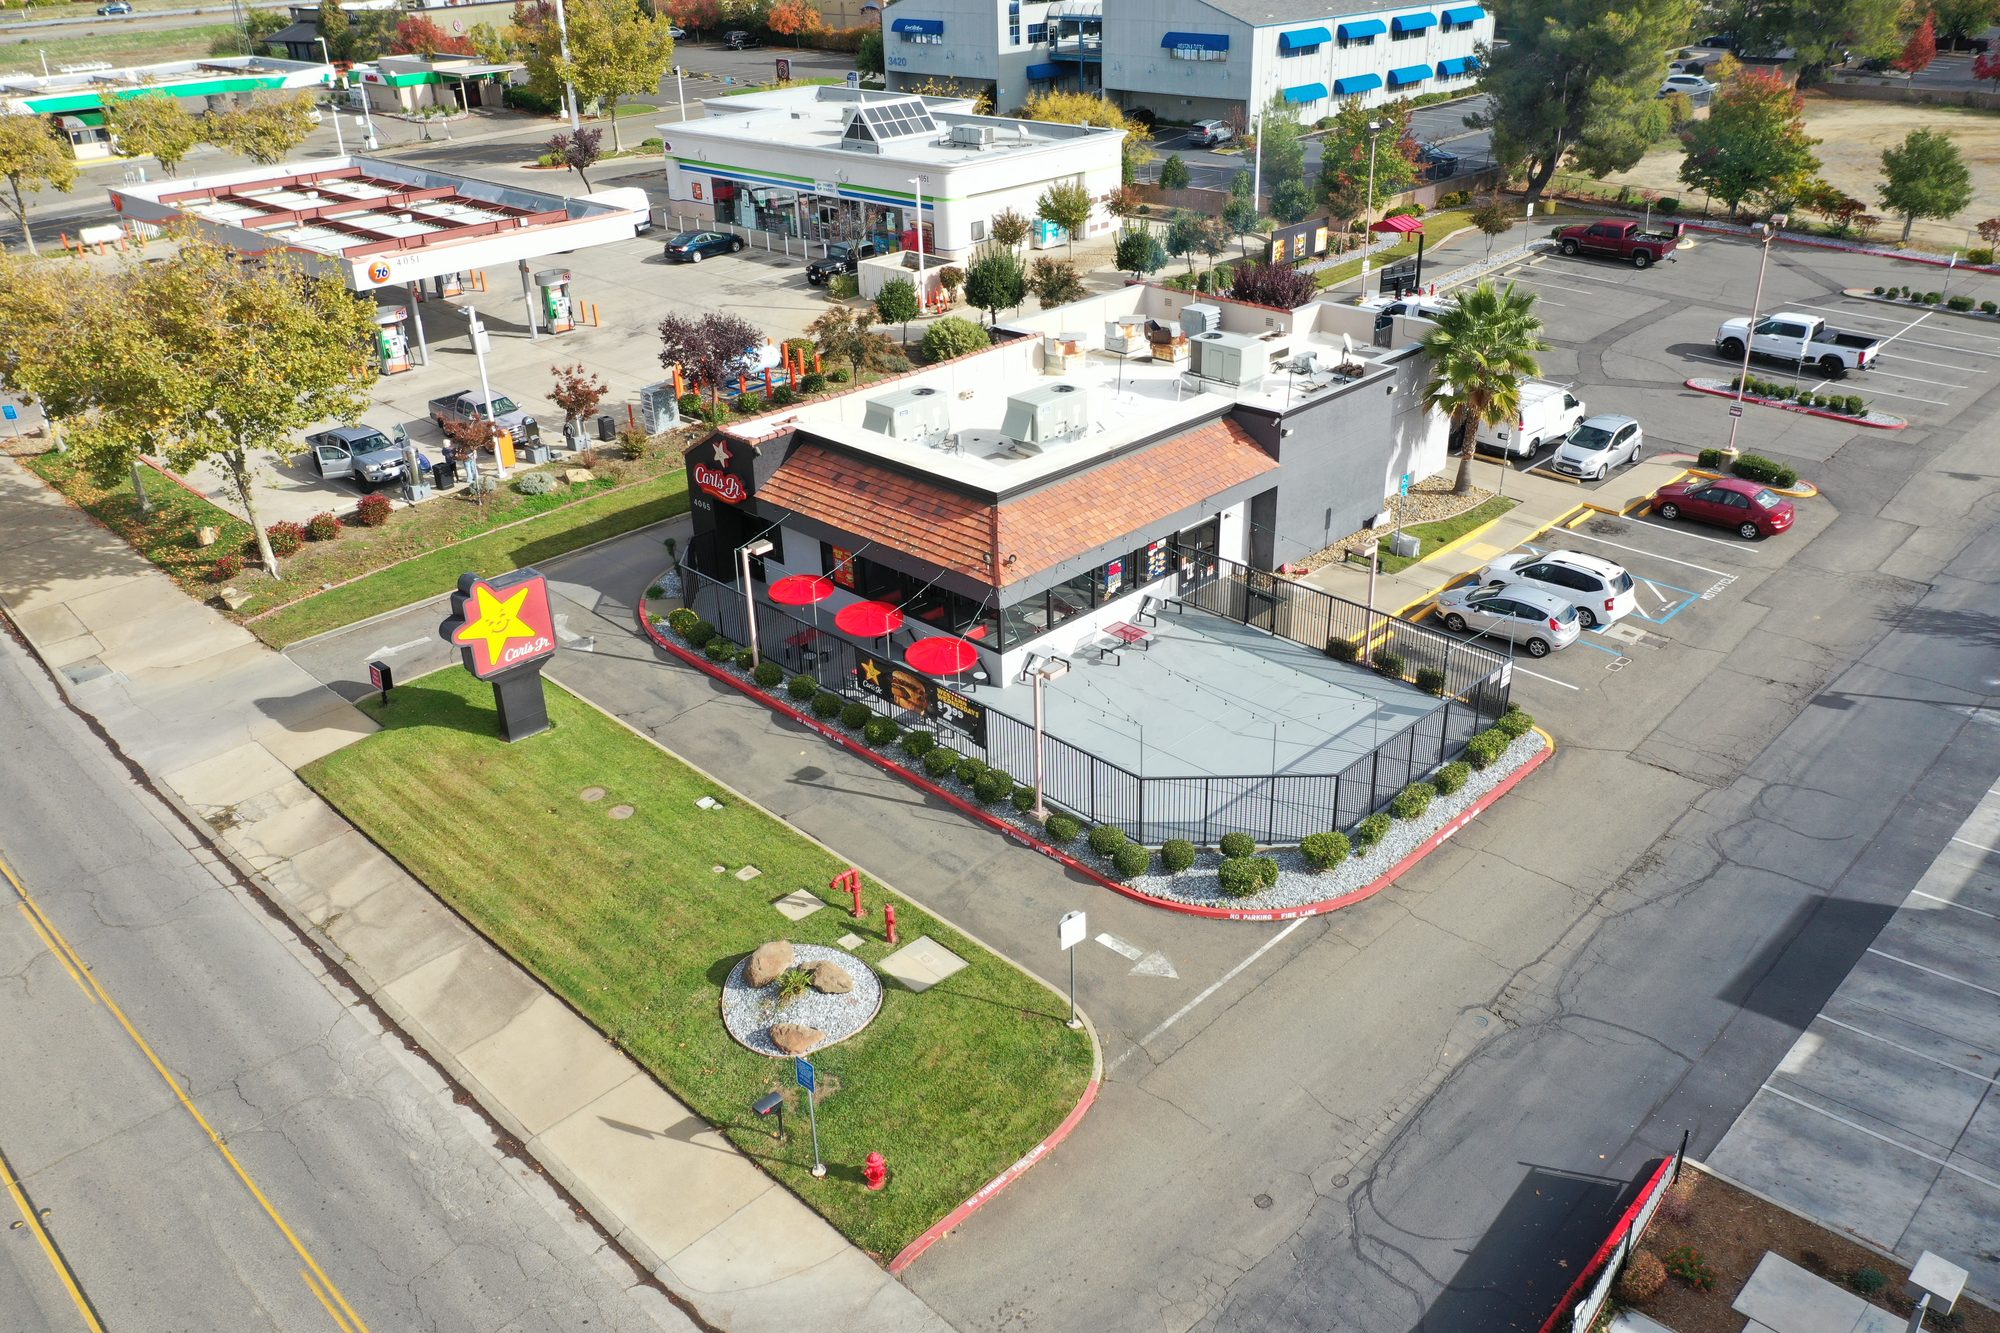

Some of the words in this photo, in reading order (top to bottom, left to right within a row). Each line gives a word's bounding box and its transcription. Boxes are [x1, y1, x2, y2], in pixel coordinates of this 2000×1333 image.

[888, 56, 907, 67] 3420
[396, 255, 420, 266] 4051
[375, 266, 388, 279] 76
[695, 466, 724, 489] Carl's
[693, 498, 711, 511] 4065
[504, 641, 535, 662] Carl's
[936, 693, 980, 719] WEDNESDAYS
[1010, 832, 1030, 846] PARKING
[1280, 911, 1297, 920] FIRE
[1299, 908, 1317, 917] LANE
[966, 1196, 978, 1208] NO
[978, 1174, 1007, 1198] PARKING
[1011, 1159, 1030, 1173] FIRE
[1029, 1143, 1047, 1159] LANE
